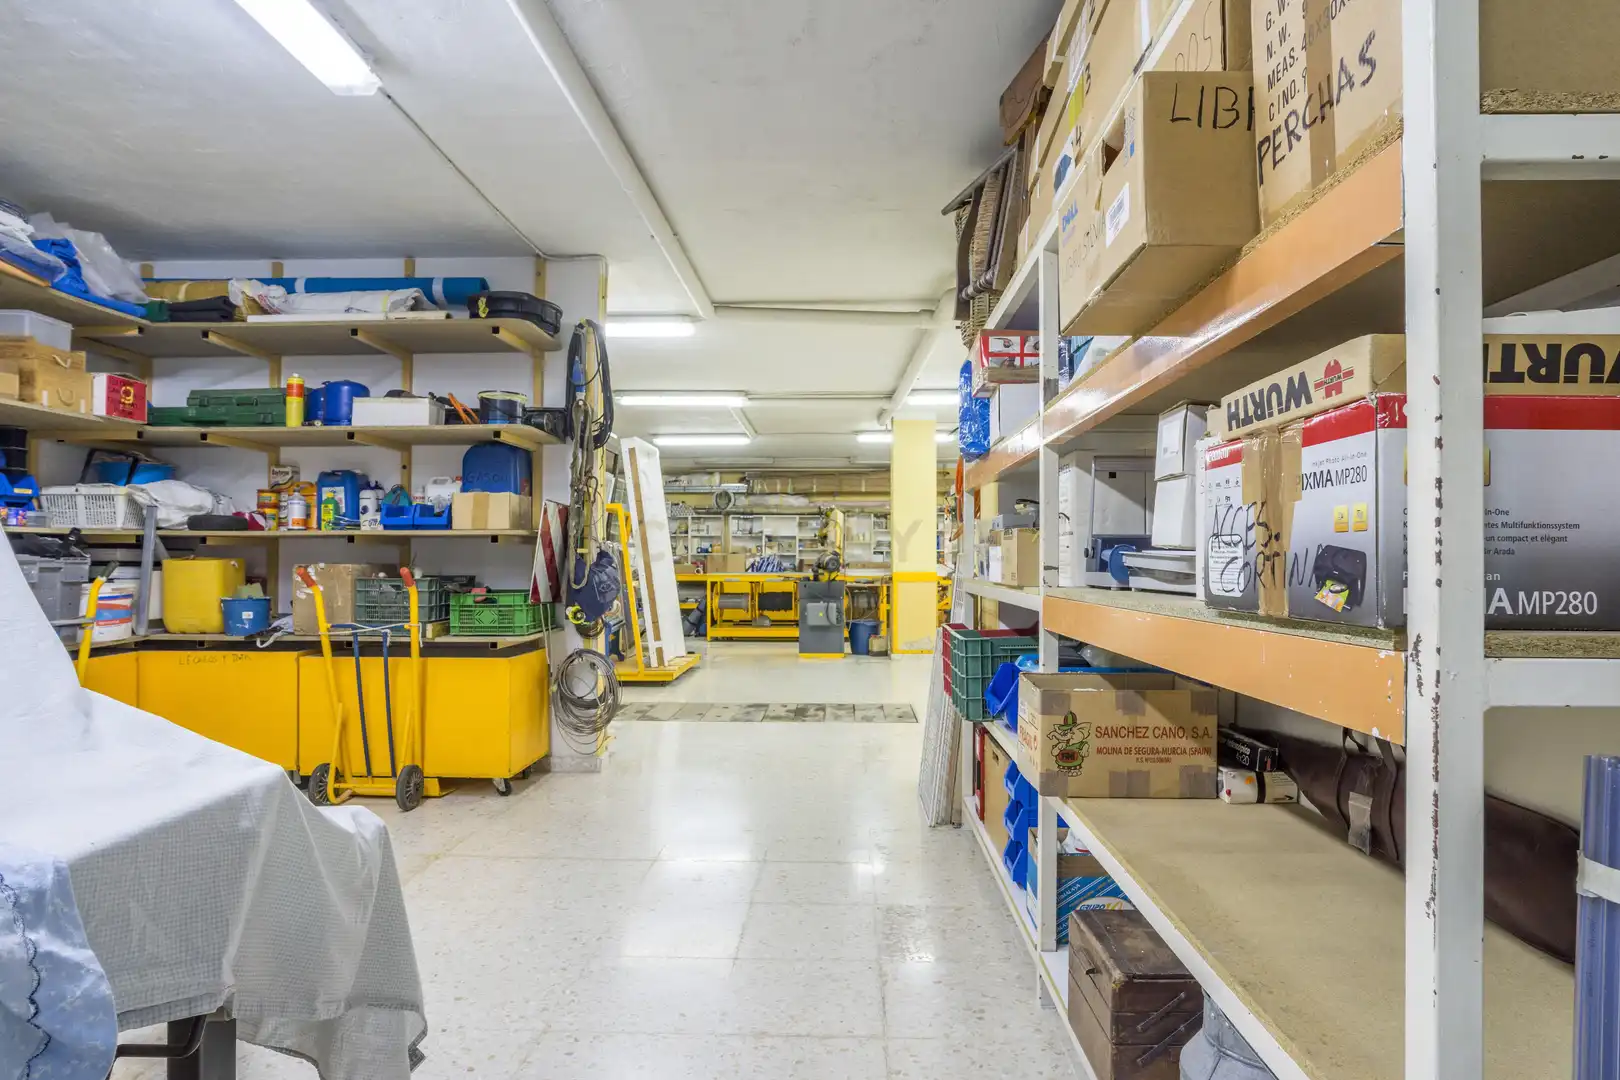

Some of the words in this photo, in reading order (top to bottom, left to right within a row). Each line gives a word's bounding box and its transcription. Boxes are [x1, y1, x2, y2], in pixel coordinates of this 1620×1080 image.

[1267, 47, 1299, 93] MEAS.
[1257, 29, 1377, 186] PERCHAS
[1335, 464, 1367, 490] MP280
[1500, 520, 1580, 532] Multifunktionssystem
[1497, 536, 1529, 544] compact
[1493, 547, 1515, 555] Arada
[1518, 590, 1598, 615] MP280
[1095, 726, 1150, 739] SANCHEZ
[1152, 726, 1188, 740] CANO,
[1191, 726, 1213, 739] S.A.
[1096, 746, 1122, 756] MOLINA
[1124, 746, 1133, 756] DE
[1134, 746, 1187, 756] SEGURA-MURCIA
[1188, 746, 1212, 758] (SPAIN)
